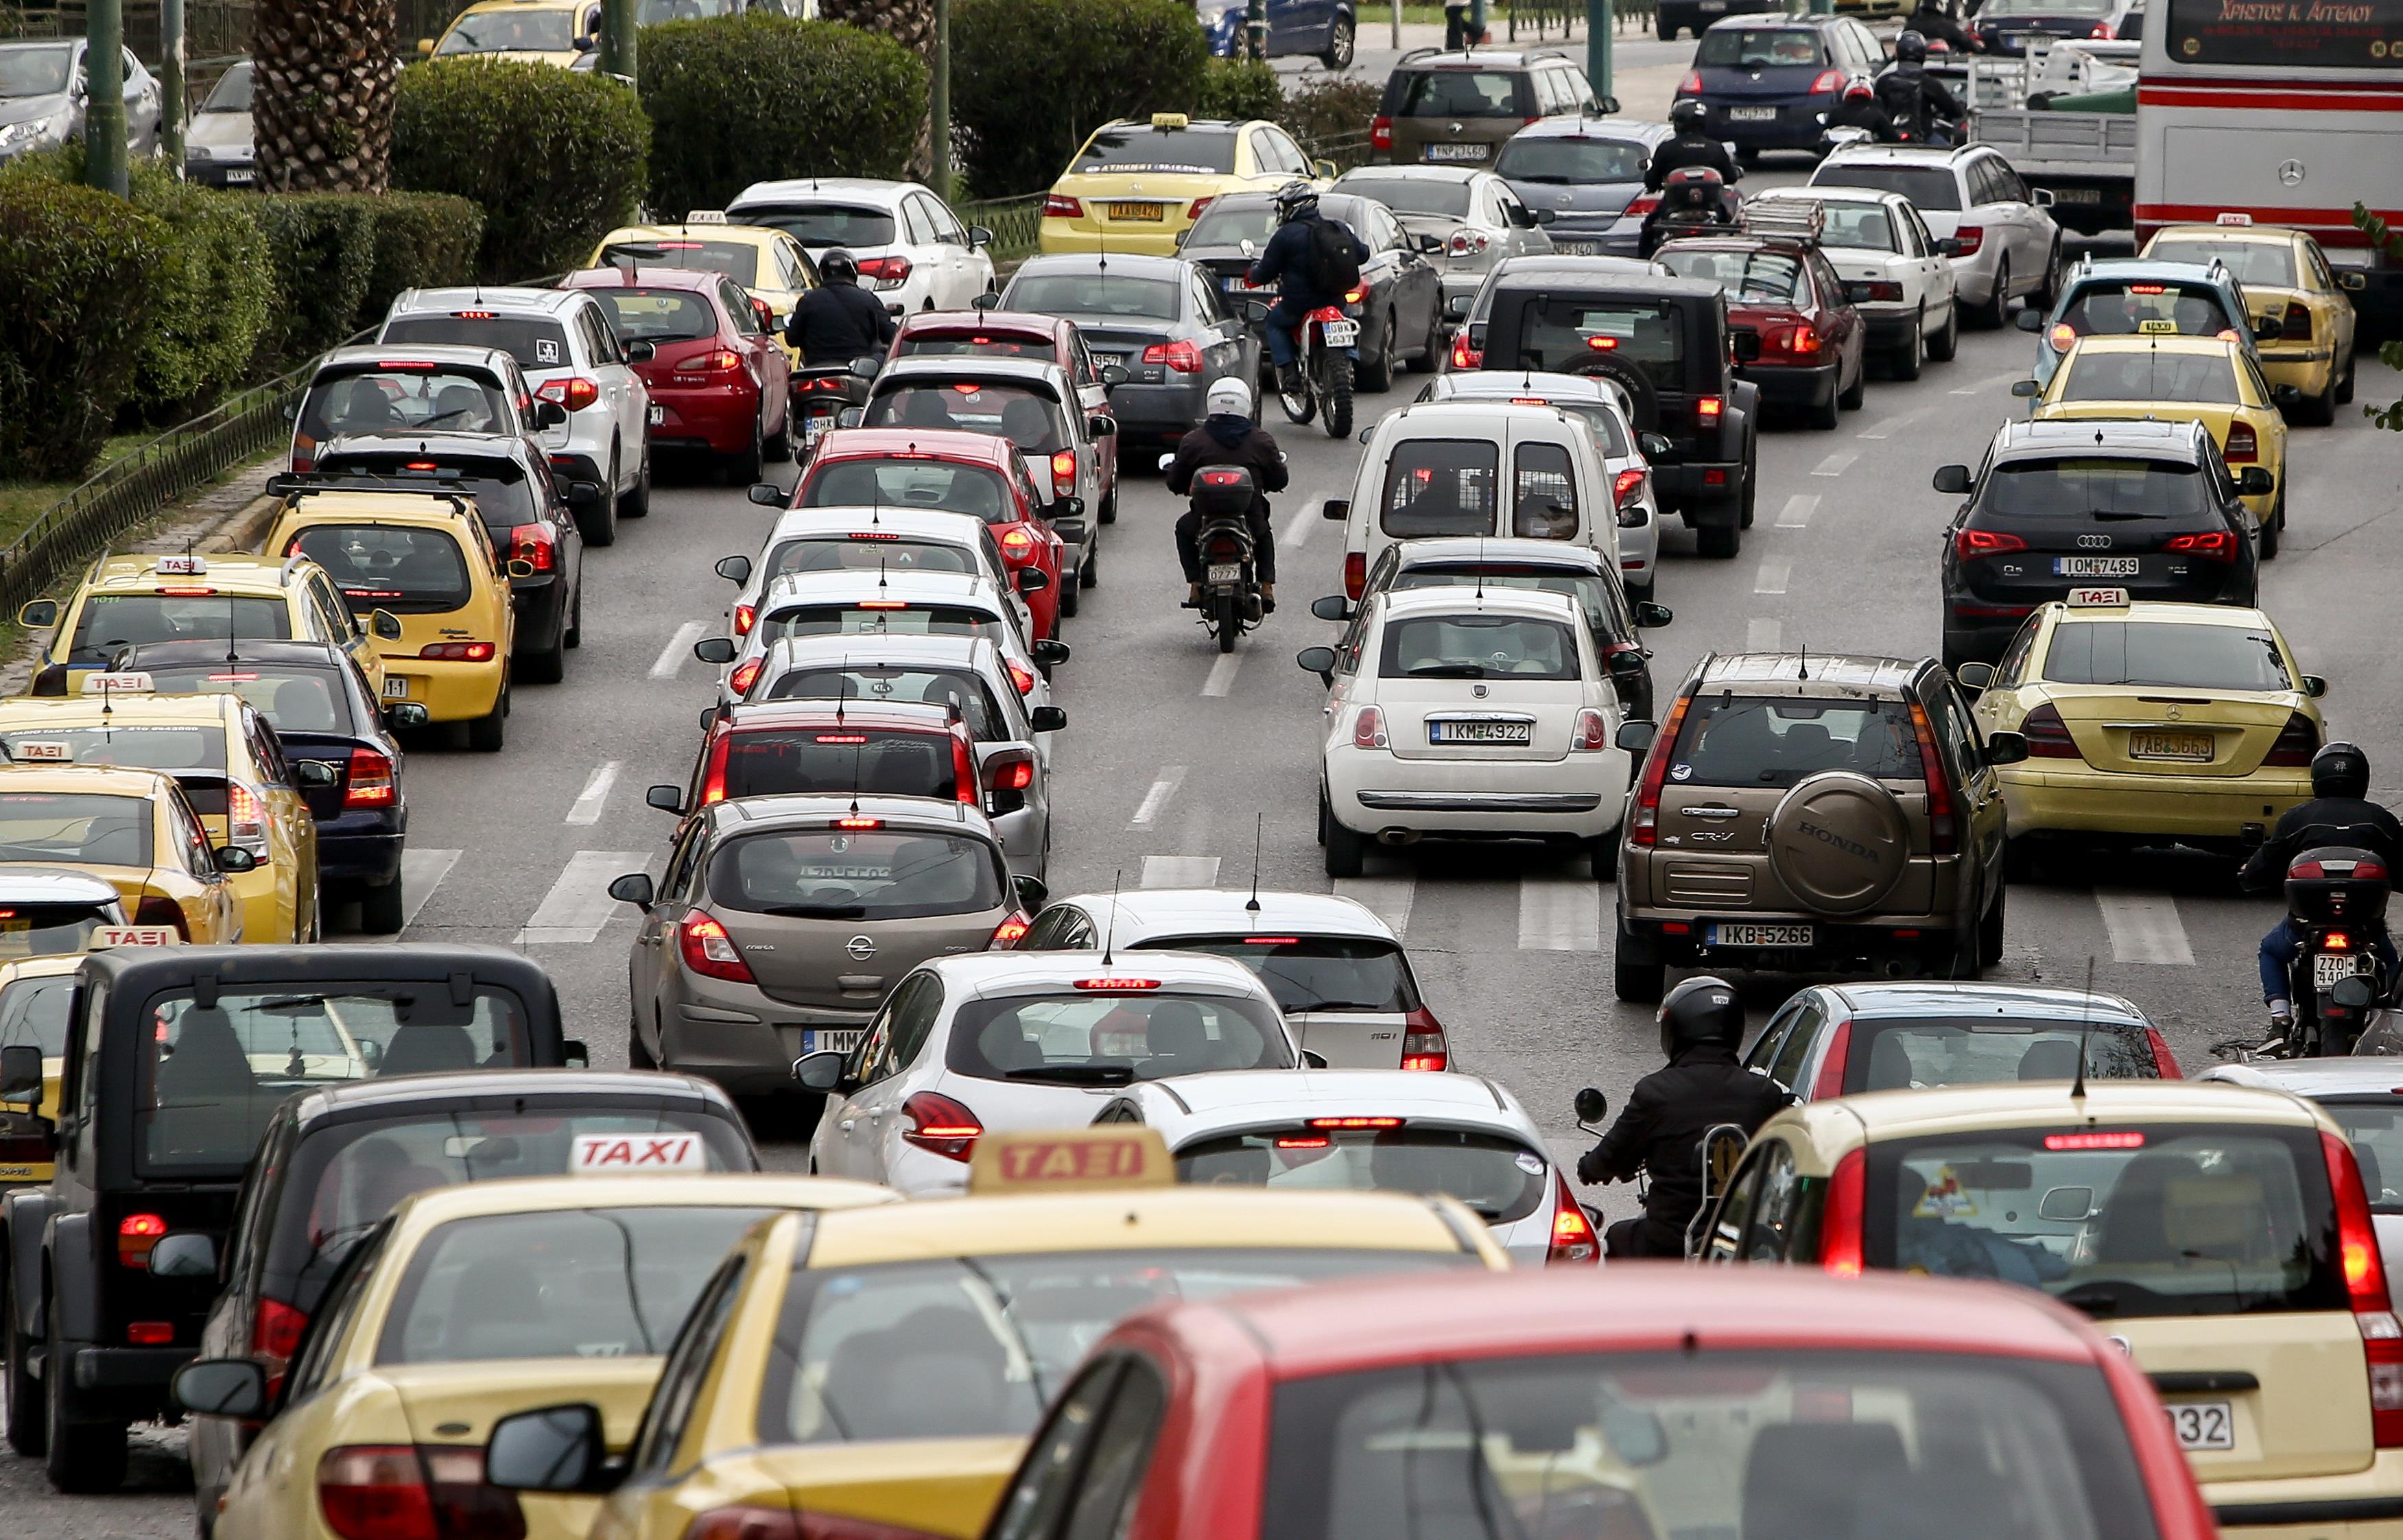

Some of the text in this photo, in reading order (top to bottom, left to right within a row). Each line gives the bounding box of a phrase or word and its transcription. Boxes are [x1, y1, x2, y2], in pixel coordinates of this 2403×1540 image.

[165, 560, 196, 570] ΤΑΞΙ
[2079, 591, 2121, 604] ΤΑΞΙ
[93, 678, 143, 689] ΤΑΞΙ
[24, 746, 62, 757] ΤΑΞΙ
[1690, 831, 1735, 841] CR-V
[1798, 820, 1880, 862] HONDA
[105, 932, 167, 945] ΤΑΞΙ
[583, 1139, 690, 1165] TAXI
[1010, 1144, 1134, 1176] ΤΑΞΙ
